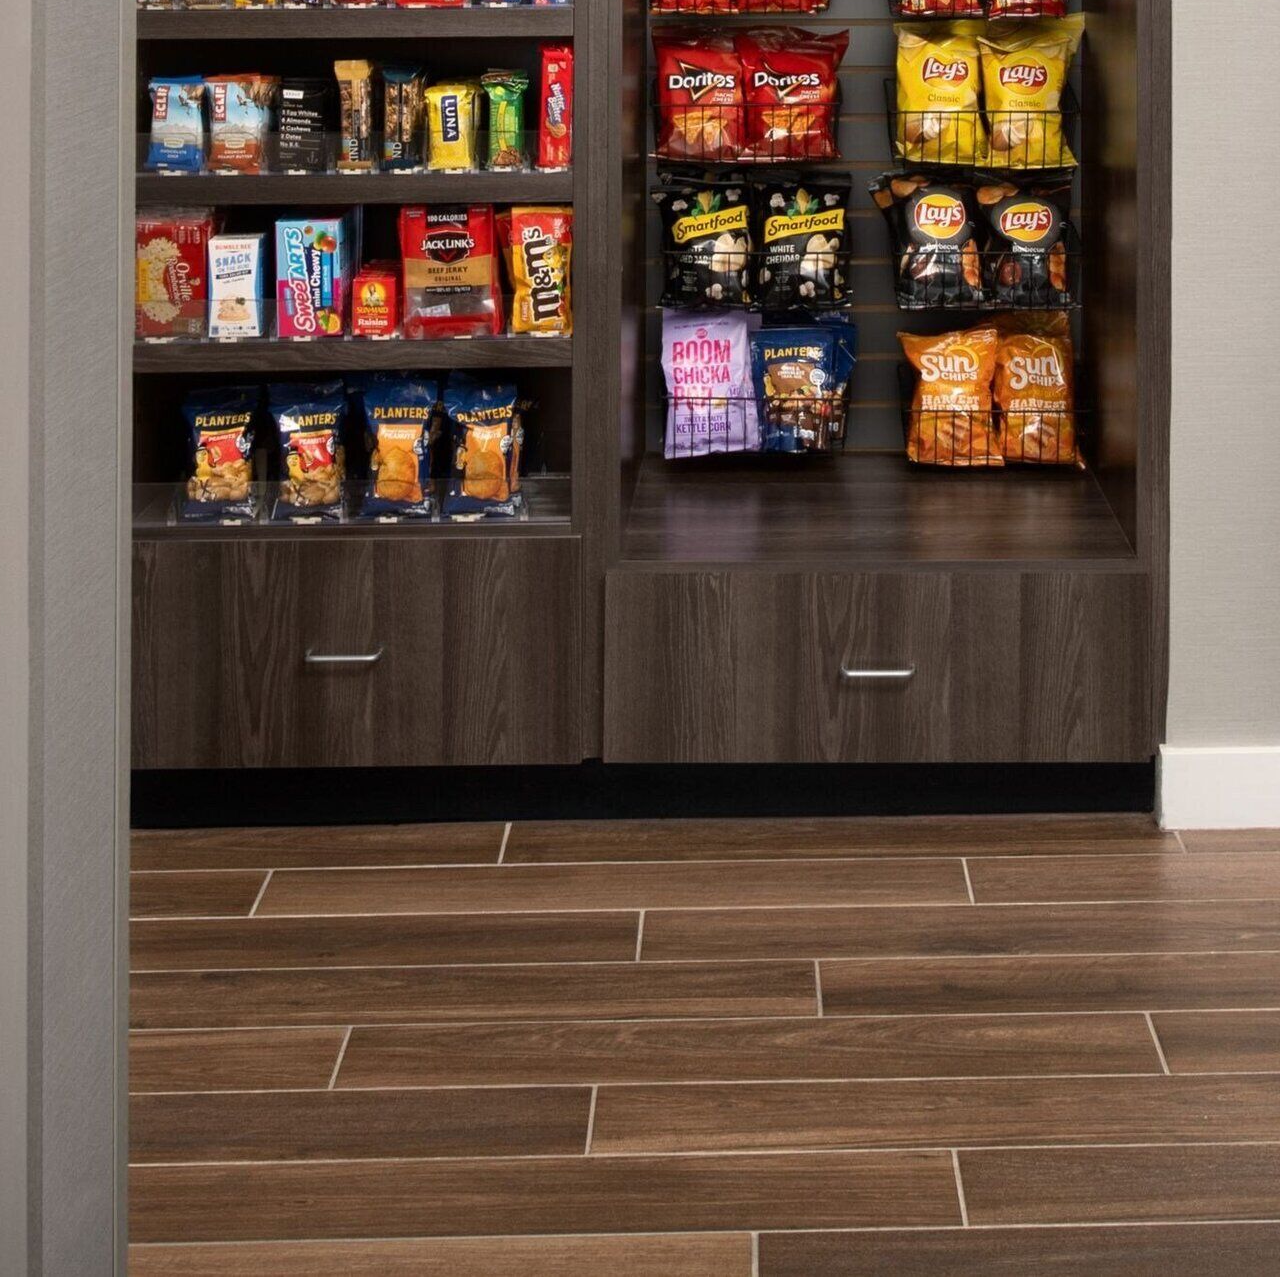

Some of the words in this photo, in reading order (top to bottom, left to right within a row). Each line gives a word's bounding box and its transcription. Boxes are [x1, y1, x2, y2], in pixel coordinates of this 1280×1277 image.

[924, 56, 968, 82] Lay's
[1002, 64, 1046, 87] Lay's
[669, 72, 736, 90] Doritos
[754, 72, 821, 88] Doritos
[156, 85, 168, 110] CLIF
[214, 85, 226, 113] CLIF
[550, 82, 565, 111] Nutter
[927, 92, 961, 104] Classic
[1008, 99, 1042, 109] Classic
[445, 98, 457, 138] LUNA
[548, 96, 562, 123] Butter
[439, 213, 467, 222] CALORIES
[919, 203, 963, 228] Lay's
[1005, 209, 1049, 232] Lay's
[676, 211, 744, 241] Smartfood
[767, 213, 839, 237] Smartfood
[421, 239, 445, 250] JACK
[770, 244, 795, 254] WHITE
[215, 253, 252, 268] SNACK
[310, 249, 322, 288] Chewy
[766, 254, 801, 265] CHEDDAR
[176, 262, 191, 302] Orville
[358, 318, 388, 326] Raisins
[672, 339, 731, 365] BOOM
[764, 346, 823, 361] PLANTERS
[920, 354, 977, 382] Sun
[940, 371, 978, 382] CHIPS
[1009, 356, 1063, 390] Sun
[1028, 375, 1064, 387] CHIPS
[921, 394, 980, 405] HARVEST
[1009, 397, 1067, 409] HARVEST
[195, 412, 251, 427] PLANTERS
[374, 406, 429, 420] PLANTERS
[457, 405, 513, 423] PLANTERS
[676, 422, 707, 434] KETTLE
[708, 421, 731, 433] CORN
